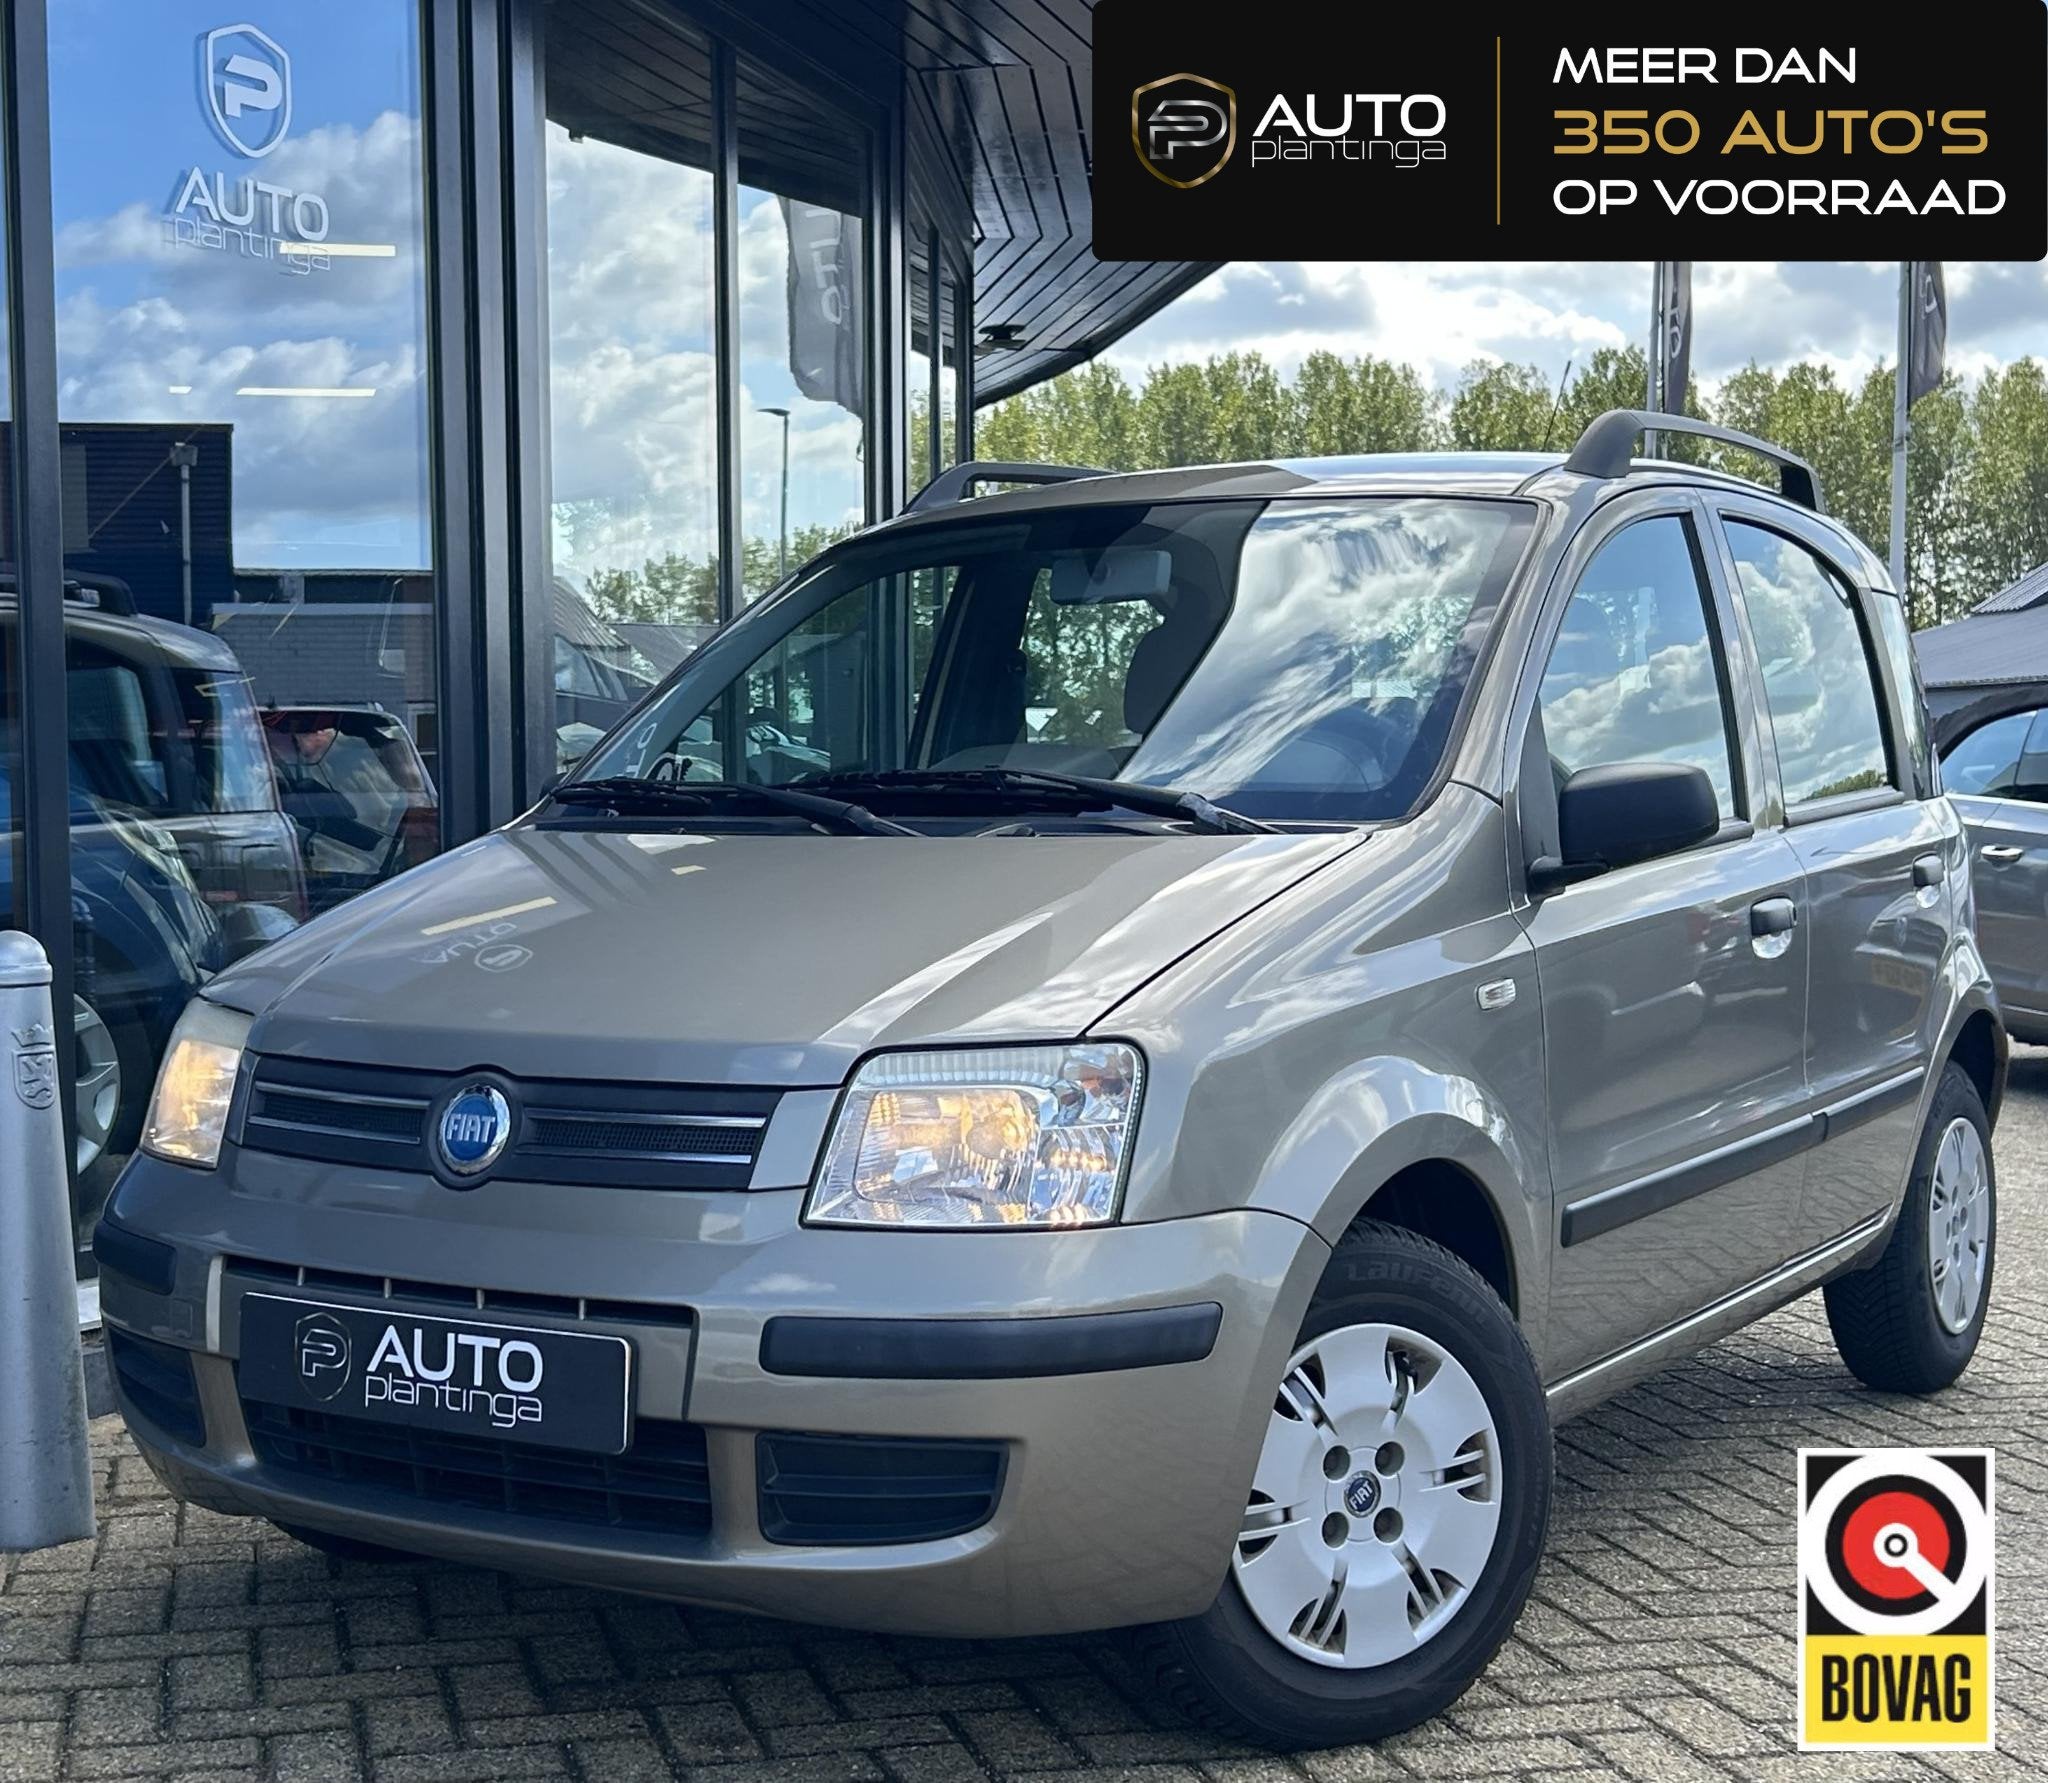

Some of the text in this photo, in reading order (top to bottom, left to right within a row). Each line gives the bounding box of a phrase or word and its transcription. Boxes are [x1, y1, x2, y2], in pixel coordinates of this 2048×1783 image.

[175, 166, 329, 241] AUTO
[174, 215, 331, 275] plantinga
[446, 1113, 496, 1143] FIAT
[366, 1325, 543, 1392] AUTO
[365, 1373, 542, 1427] plantinga
[1349, 1481, 1373, 1509] FIAT
